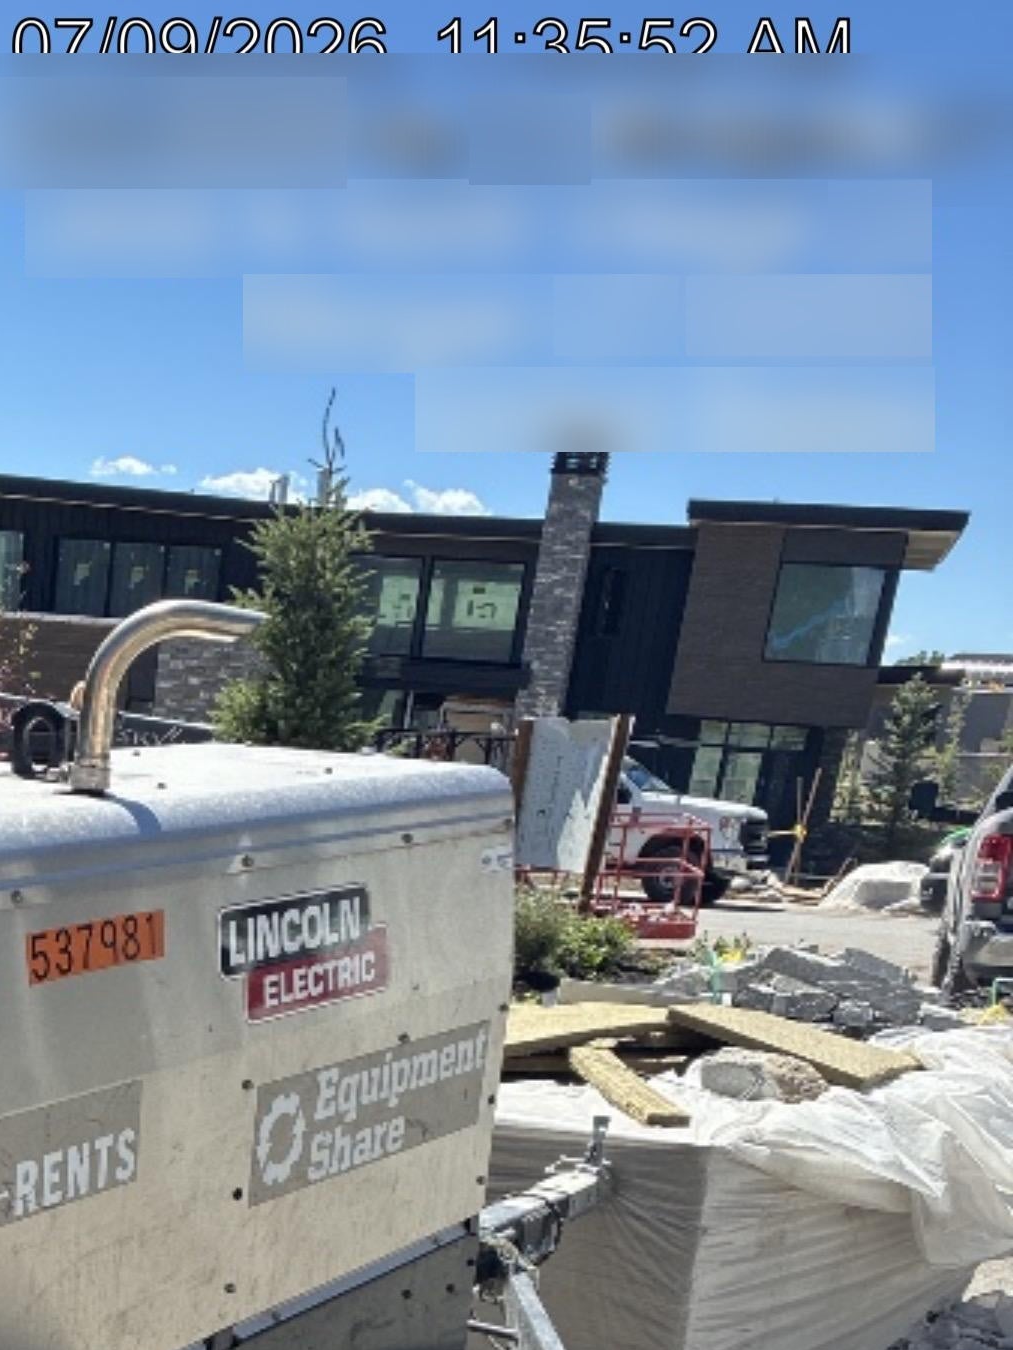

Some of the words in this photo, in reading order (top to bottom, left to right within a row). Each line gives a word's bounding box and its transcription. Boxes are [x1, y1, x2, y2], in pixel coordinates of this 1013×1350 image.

[30, 914, 158, 983] 537981
[229, 896, 361, 967] LINCOLN
[263, 950, 376, 1009] ELECTRIC
[314, 1029, 486, 1122] Equipment
[307, 1114, 406, 1181] Share
